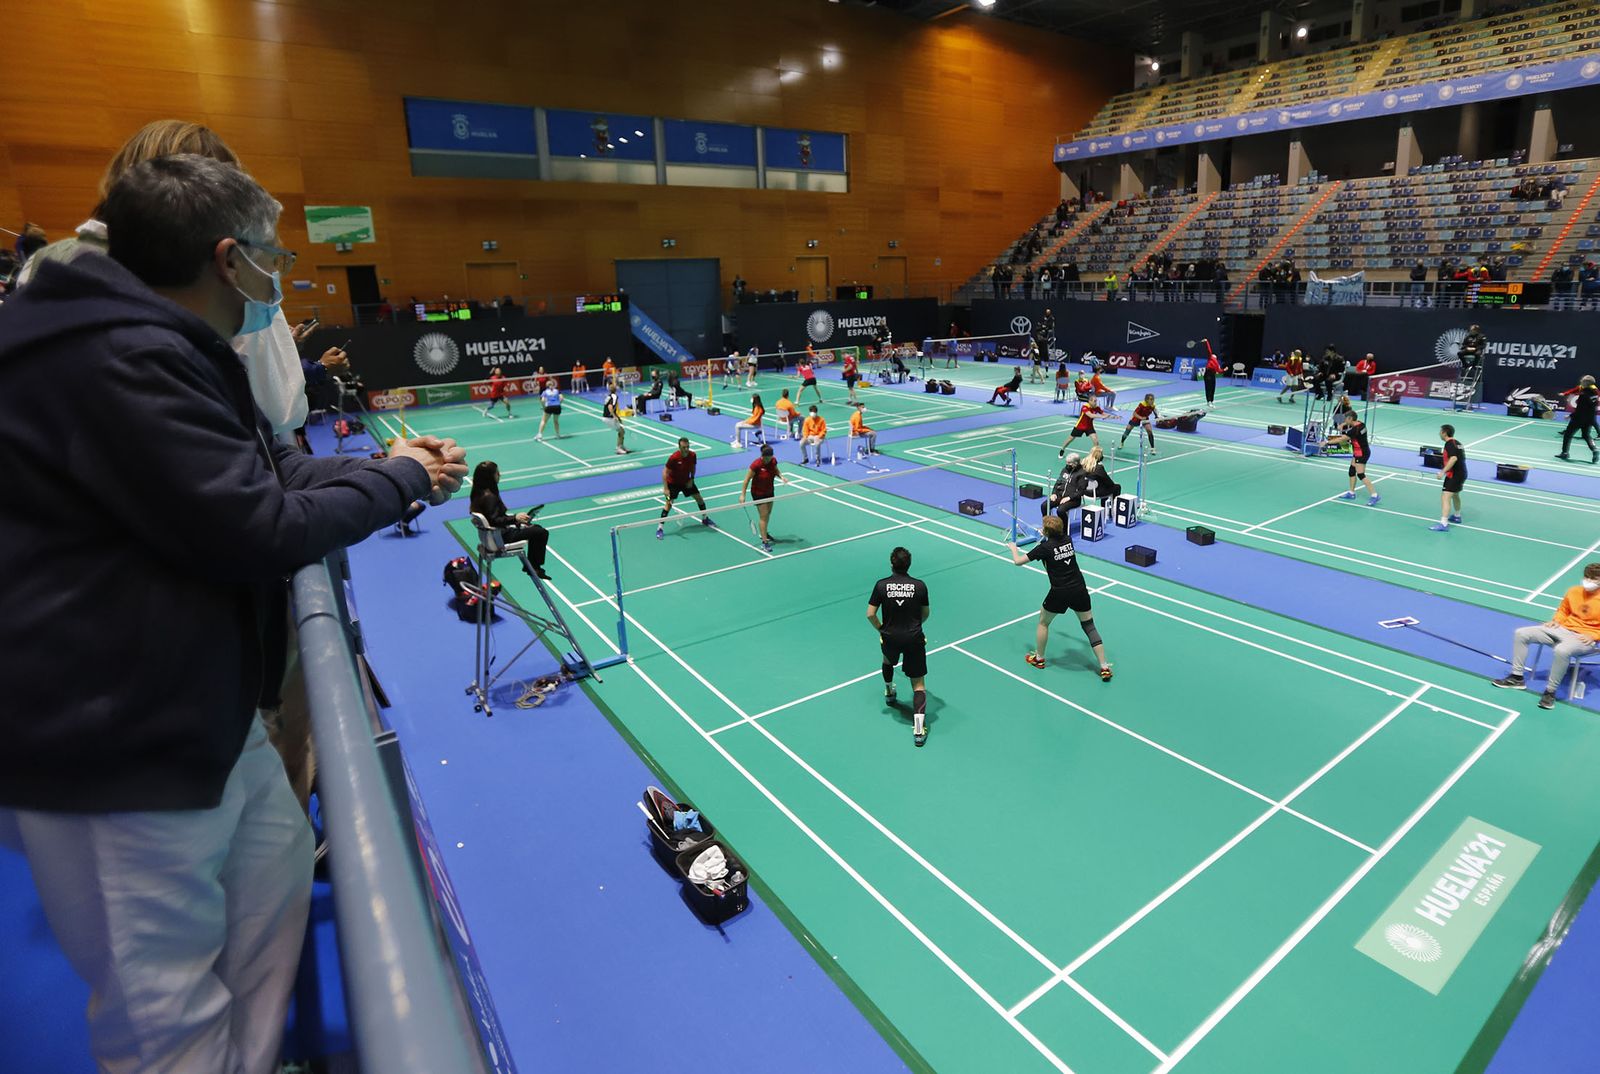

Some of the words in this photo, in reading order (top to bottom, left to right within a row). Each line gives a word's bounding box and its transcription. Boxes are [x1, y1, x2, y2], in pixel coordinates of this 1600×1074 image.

[1511, 295, 1518, 304] 0
[847, 327, 878, 337] ESPAÑA
[466, 337, 546, 356] HUELVA'21
[1485, 341, 1577, 359] HUELVA'21
[482, 351, 534, 366] ESPAÑA
[1498, 357, 1557, 370] ESPAÑA
[1119, 501, 1126, 512] 5
[1084, 513, 1092, 524] 4
[1053, 550, 1075, 561] GERMAN
[886, 583, 915, 592] FISCHER
[886, 590, 915, 598] GERMANY
[1414, 832, 1506, 927] HUELVA'21
[1473, 873, 1506, 907] ESPAÑA
